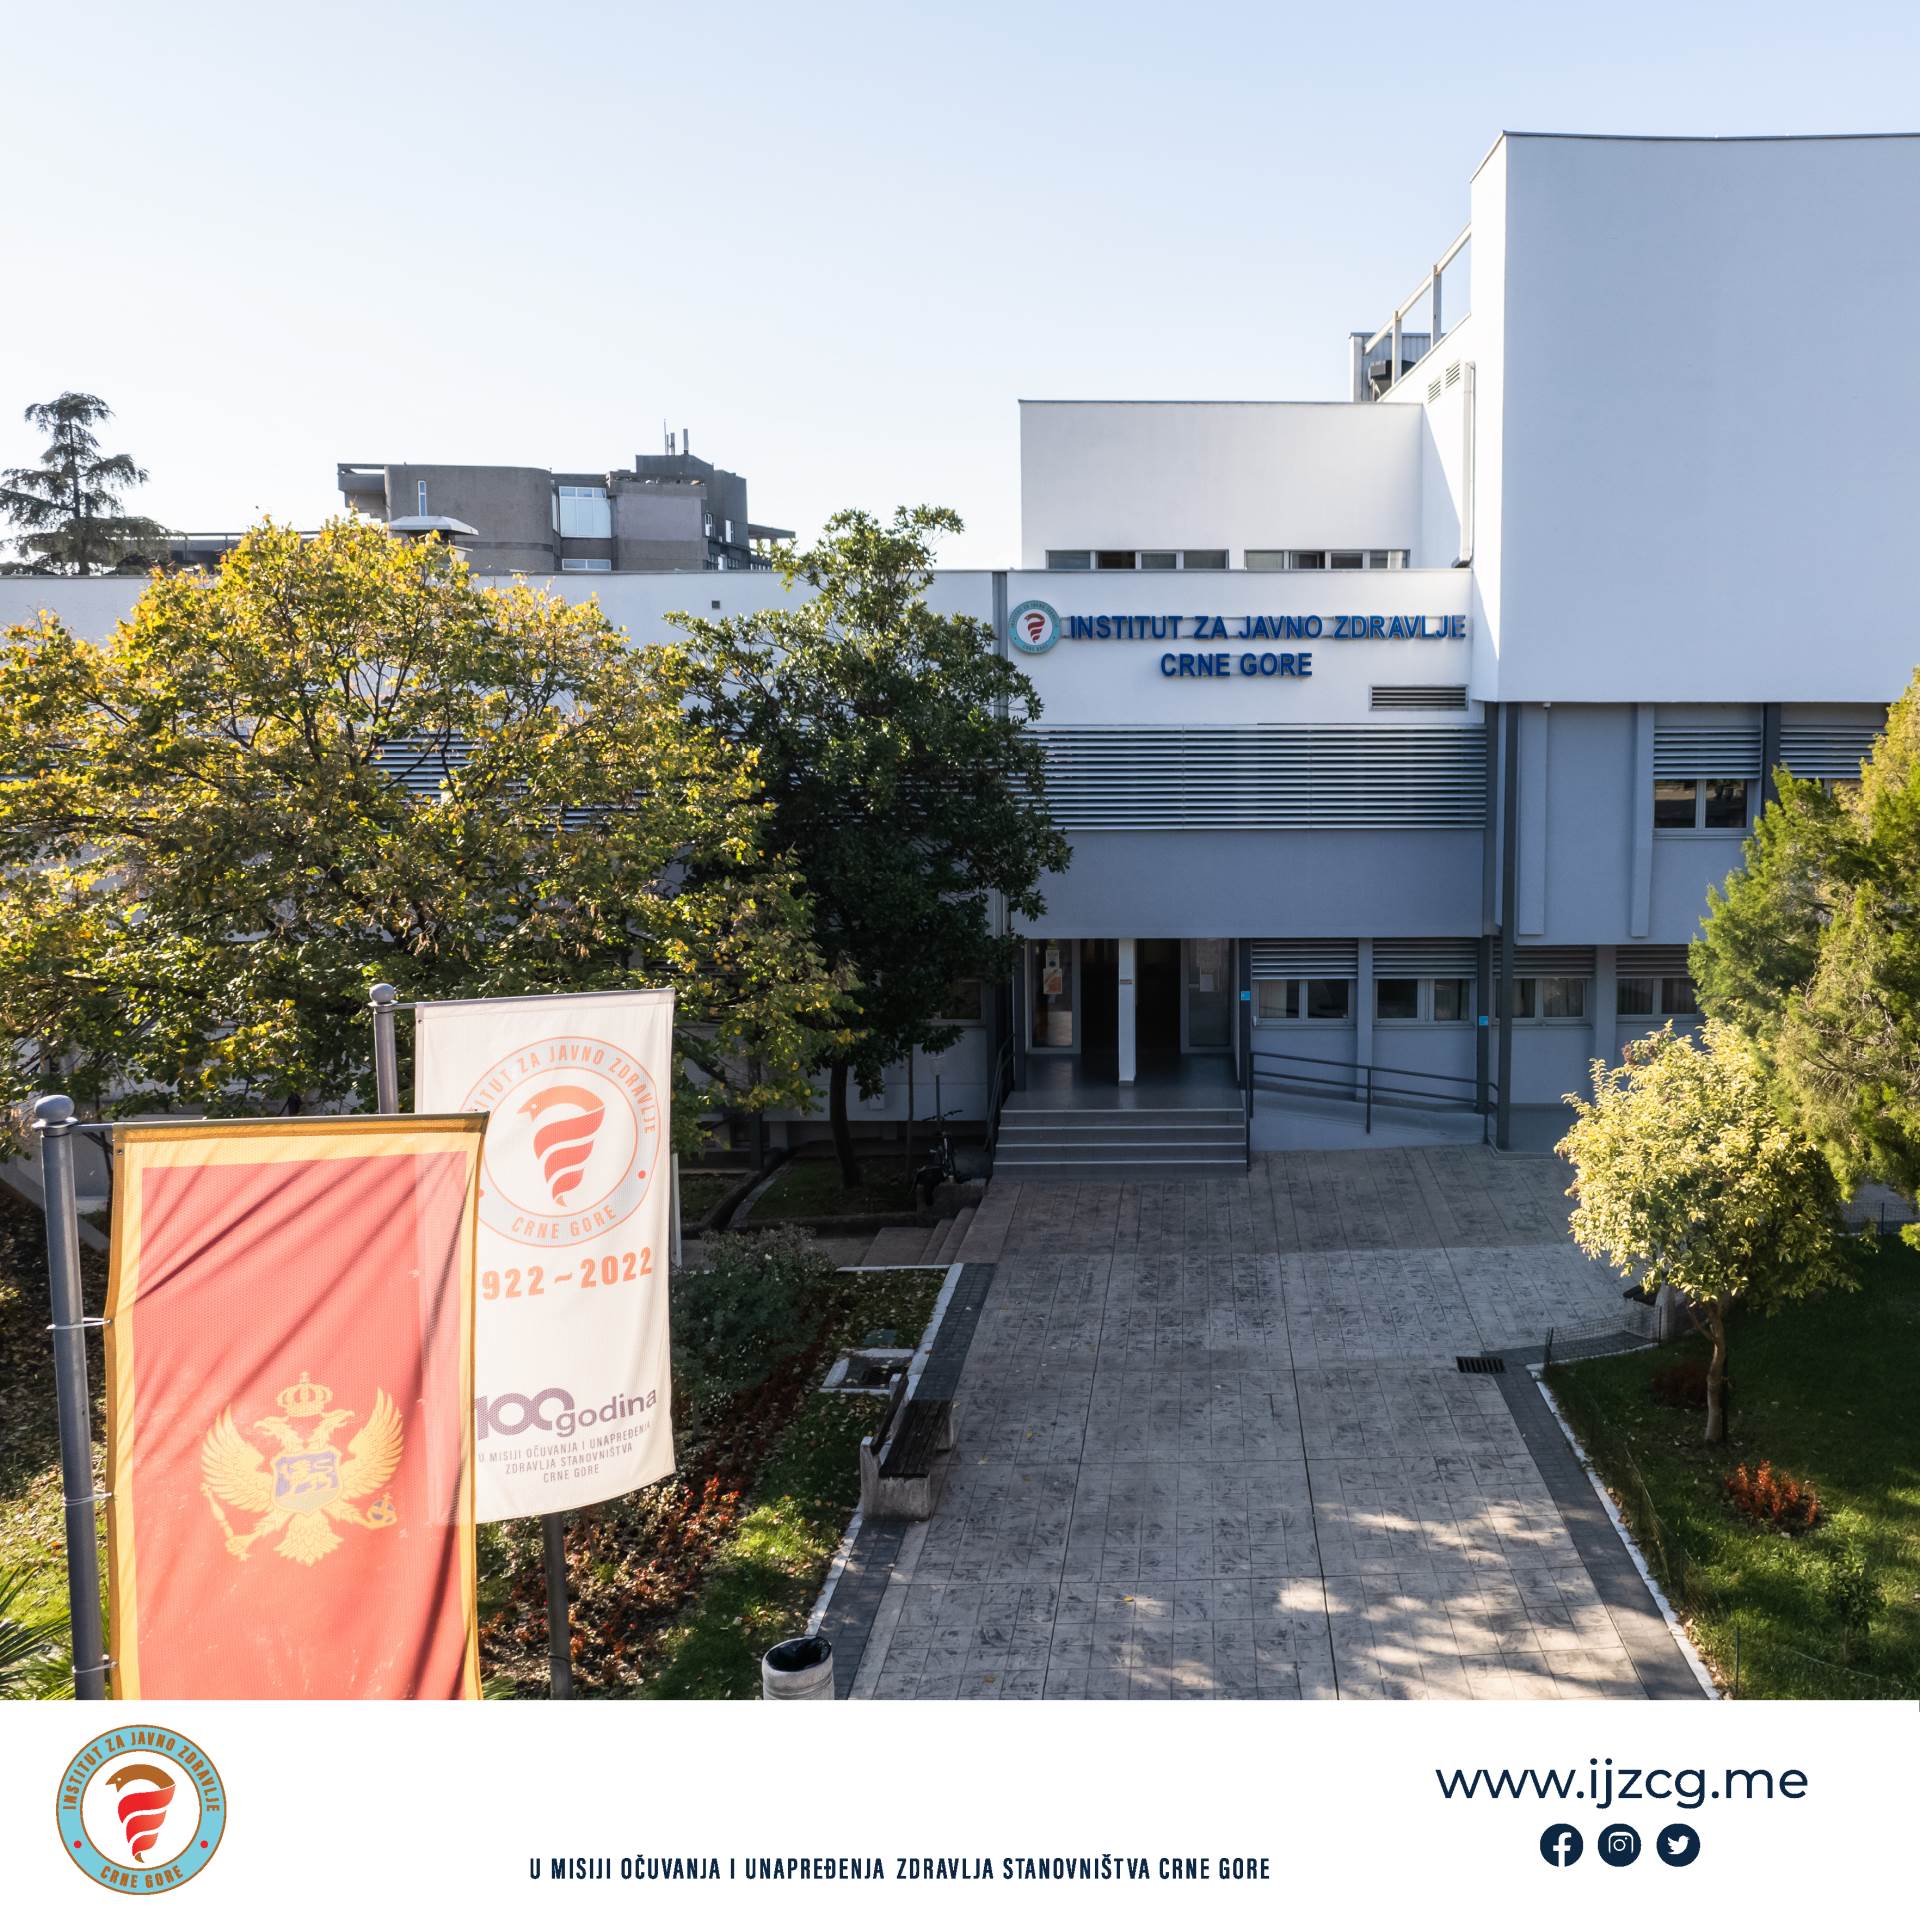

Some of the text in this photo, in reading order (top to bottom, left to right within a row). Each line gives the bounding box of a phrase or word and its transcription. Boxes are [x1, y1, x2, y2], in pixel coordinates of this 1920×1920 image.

[1069, 614, 1184, 641] INSTITUT
[1192, 614, 1229, 641] ZA
[1237, 614, 1324, 641] JAVNO
[1333, 614, 1467, 641] ZDRAVLJE
[1160, 652, 1313, 678] CRNE GORE
[518, 1051, 541, 1073] ZA
[549, 1044, 604, 1065] JAVNO
[608, 1056, 656, 1134] ZDRAVLJE
[511, 1204, 617, 1239] CRNE GORE
[481, 1265, 545, 1301] 922
[555, 1388, 657, 1438] godina
[490, 1449, 521, 1462] MISIJI
[505, 1458, 556, 1475] ZDRAVLJA
[543, 1463, 599, 1484] CRNE GORE
